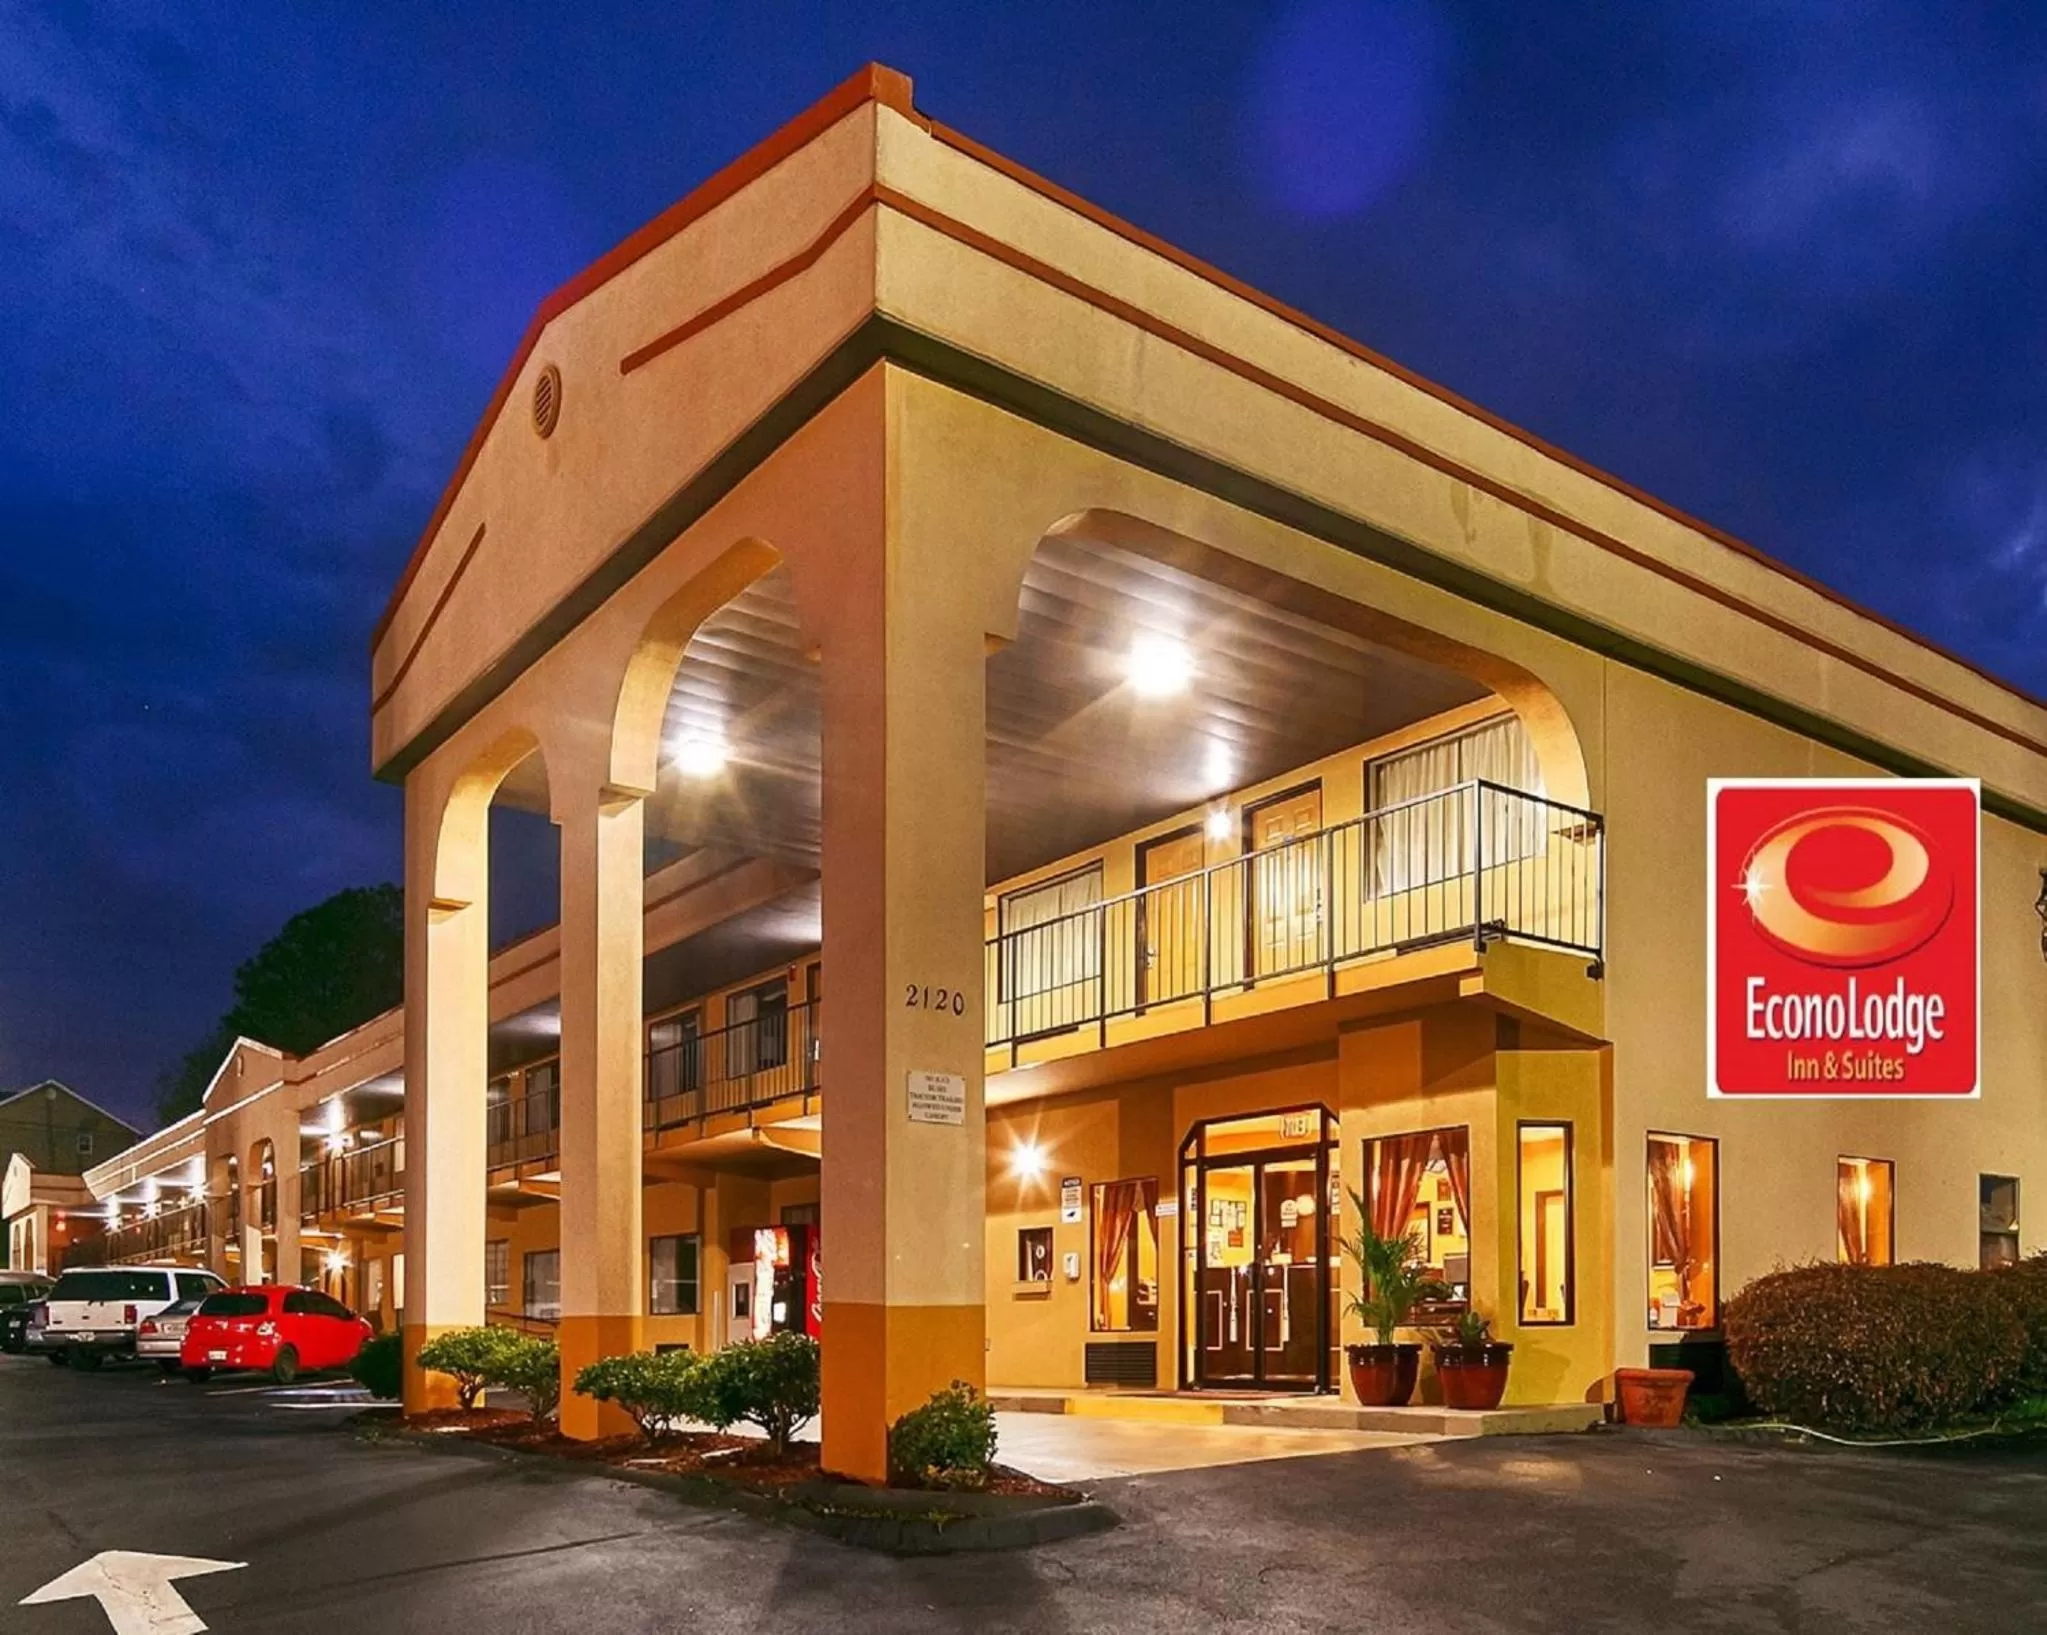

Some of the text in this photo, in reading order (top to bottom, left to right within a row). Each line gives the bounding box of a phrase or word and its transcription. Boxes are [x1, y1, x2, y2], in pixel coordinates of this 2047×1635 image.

[905, 984, 965, 1016] 2120
[1747, 976, 1945, 1054] EconoLodge
[1788, 1050, 1904, 1080] Inn & Suites
